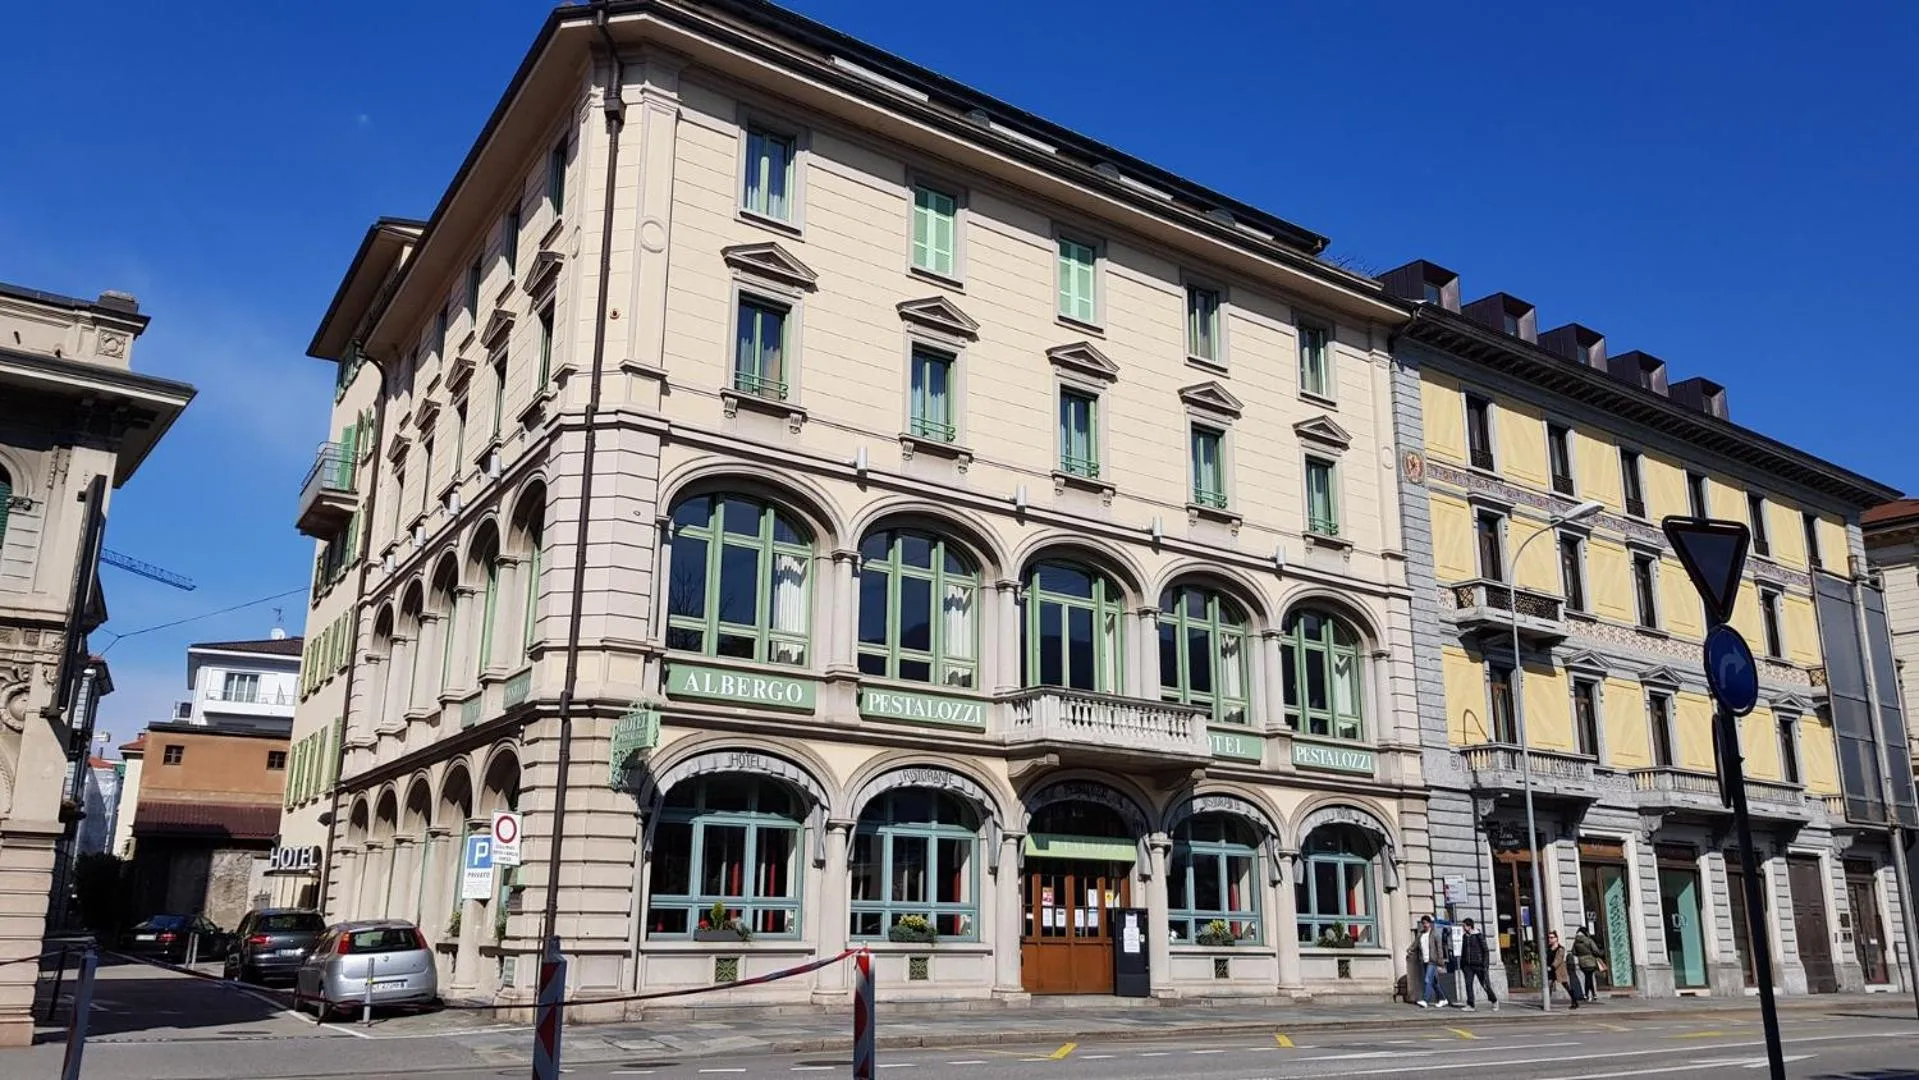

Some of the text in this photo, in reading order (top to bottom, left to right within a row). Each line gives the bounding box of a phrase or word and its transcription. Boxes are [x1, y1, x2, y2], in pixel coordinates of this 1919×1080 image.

[683, 671, 803, 703] ALBERGO
[867, 692, 982, 724] PESTALOZZI
[731, 753, 761, 768] HOTEL
[1295, 745, 1373, 771] PESTALOZZI
[903, 769, 955, 785] RISTORANTE
[269, 846, 318, 870] HOTEL
